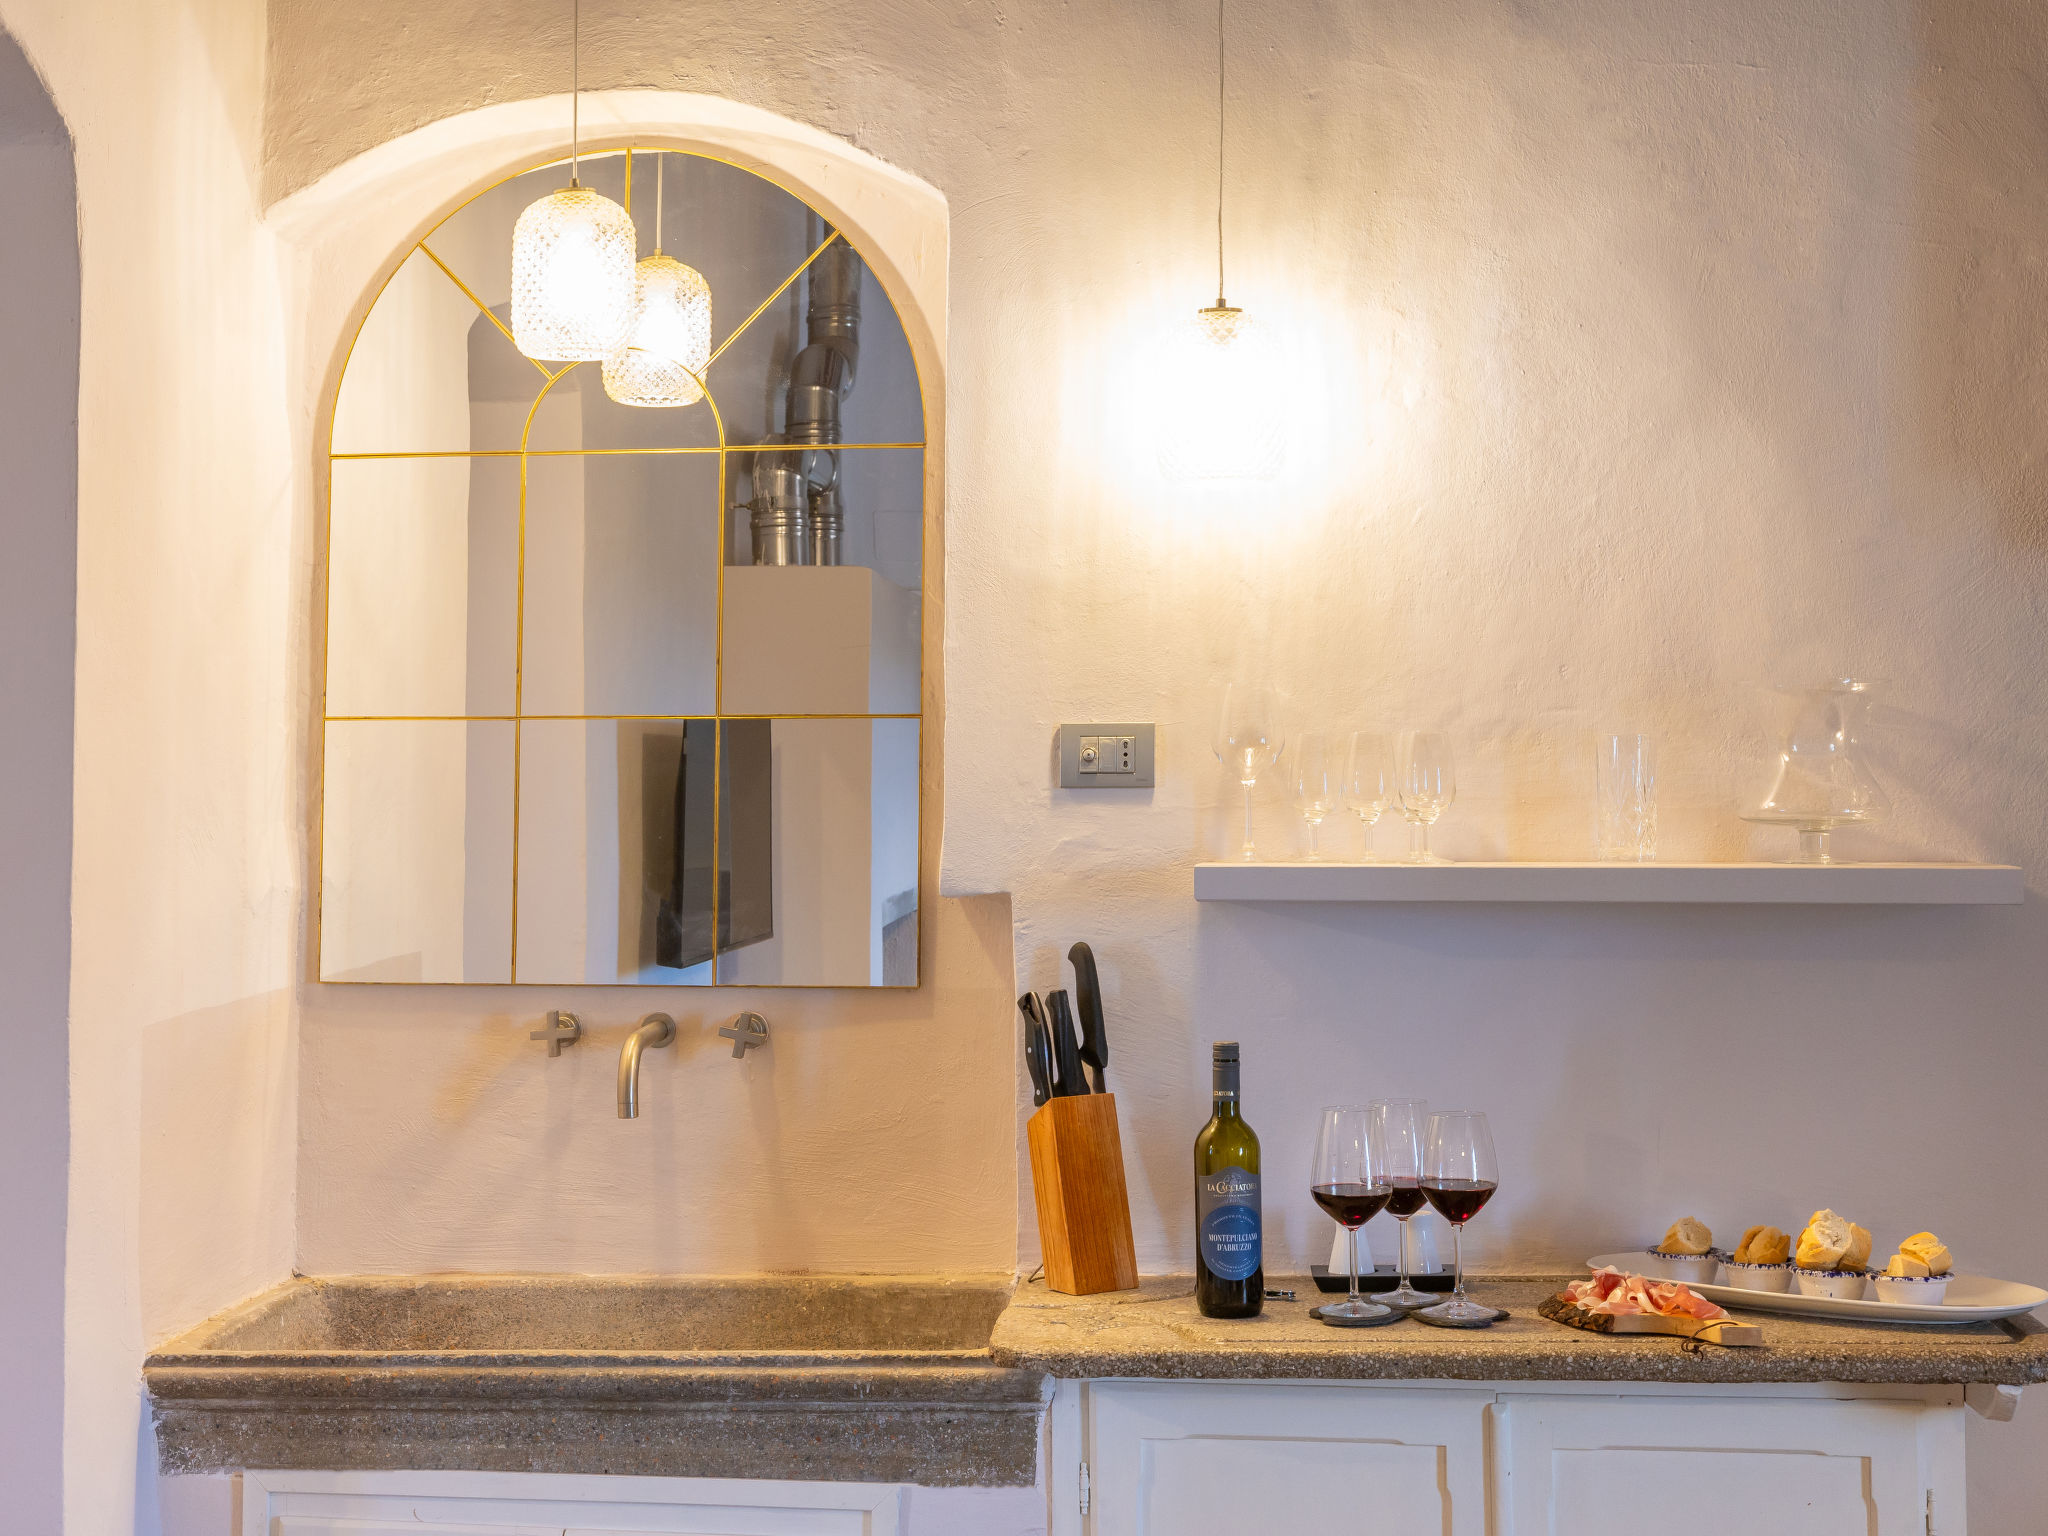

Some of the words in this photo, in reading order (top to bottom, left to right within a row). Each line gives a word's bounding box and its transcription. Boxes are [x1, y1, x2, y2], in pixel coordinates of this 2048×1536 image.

[1207, 1183, 1215, 1191] LA
[1208, 1232, 1258, 1242] MONTEPULCIANO
[1217, 1243, 1252, 1252] D'ABRUZZO
